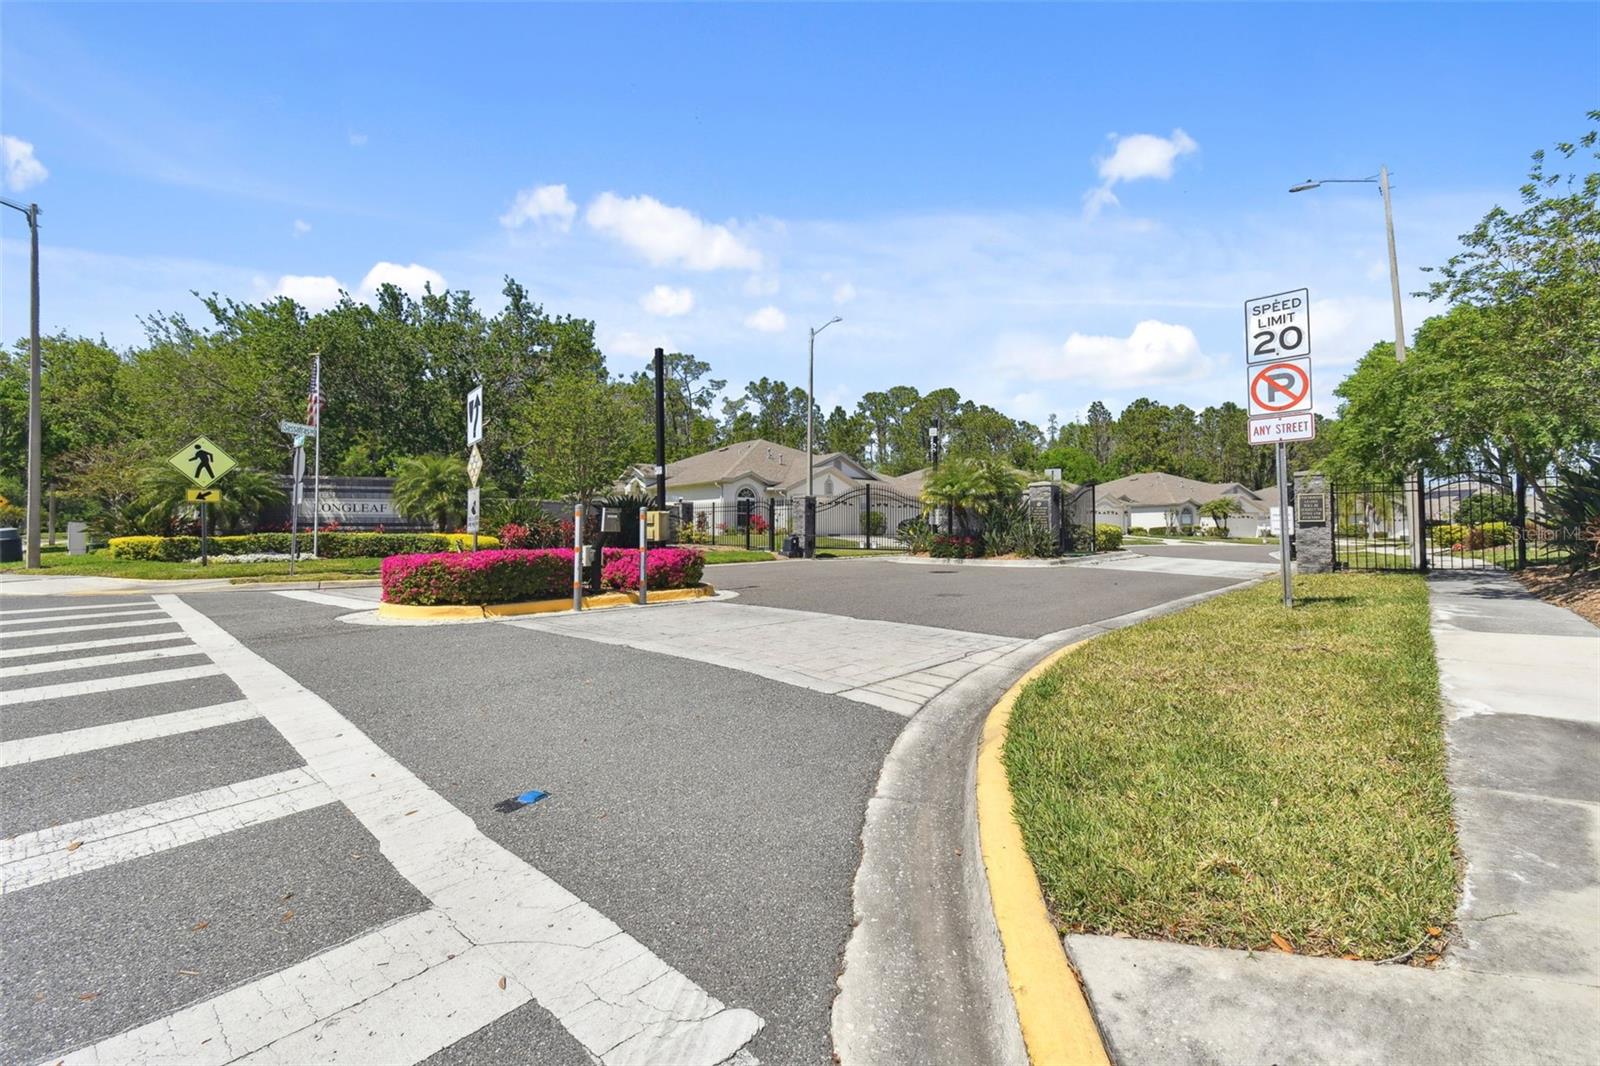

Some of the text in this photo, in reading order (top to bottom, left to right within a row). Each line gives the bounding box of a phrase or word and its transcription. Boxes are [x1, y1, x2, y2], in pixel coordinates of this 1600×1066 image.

[1252, 298, 1302, 316] SPEED
[1258, 312, 1296, 329] LIMIT
[1253, 325, 1303, 356] 20
[1253, 421, 1308, 437] ANY STREET
